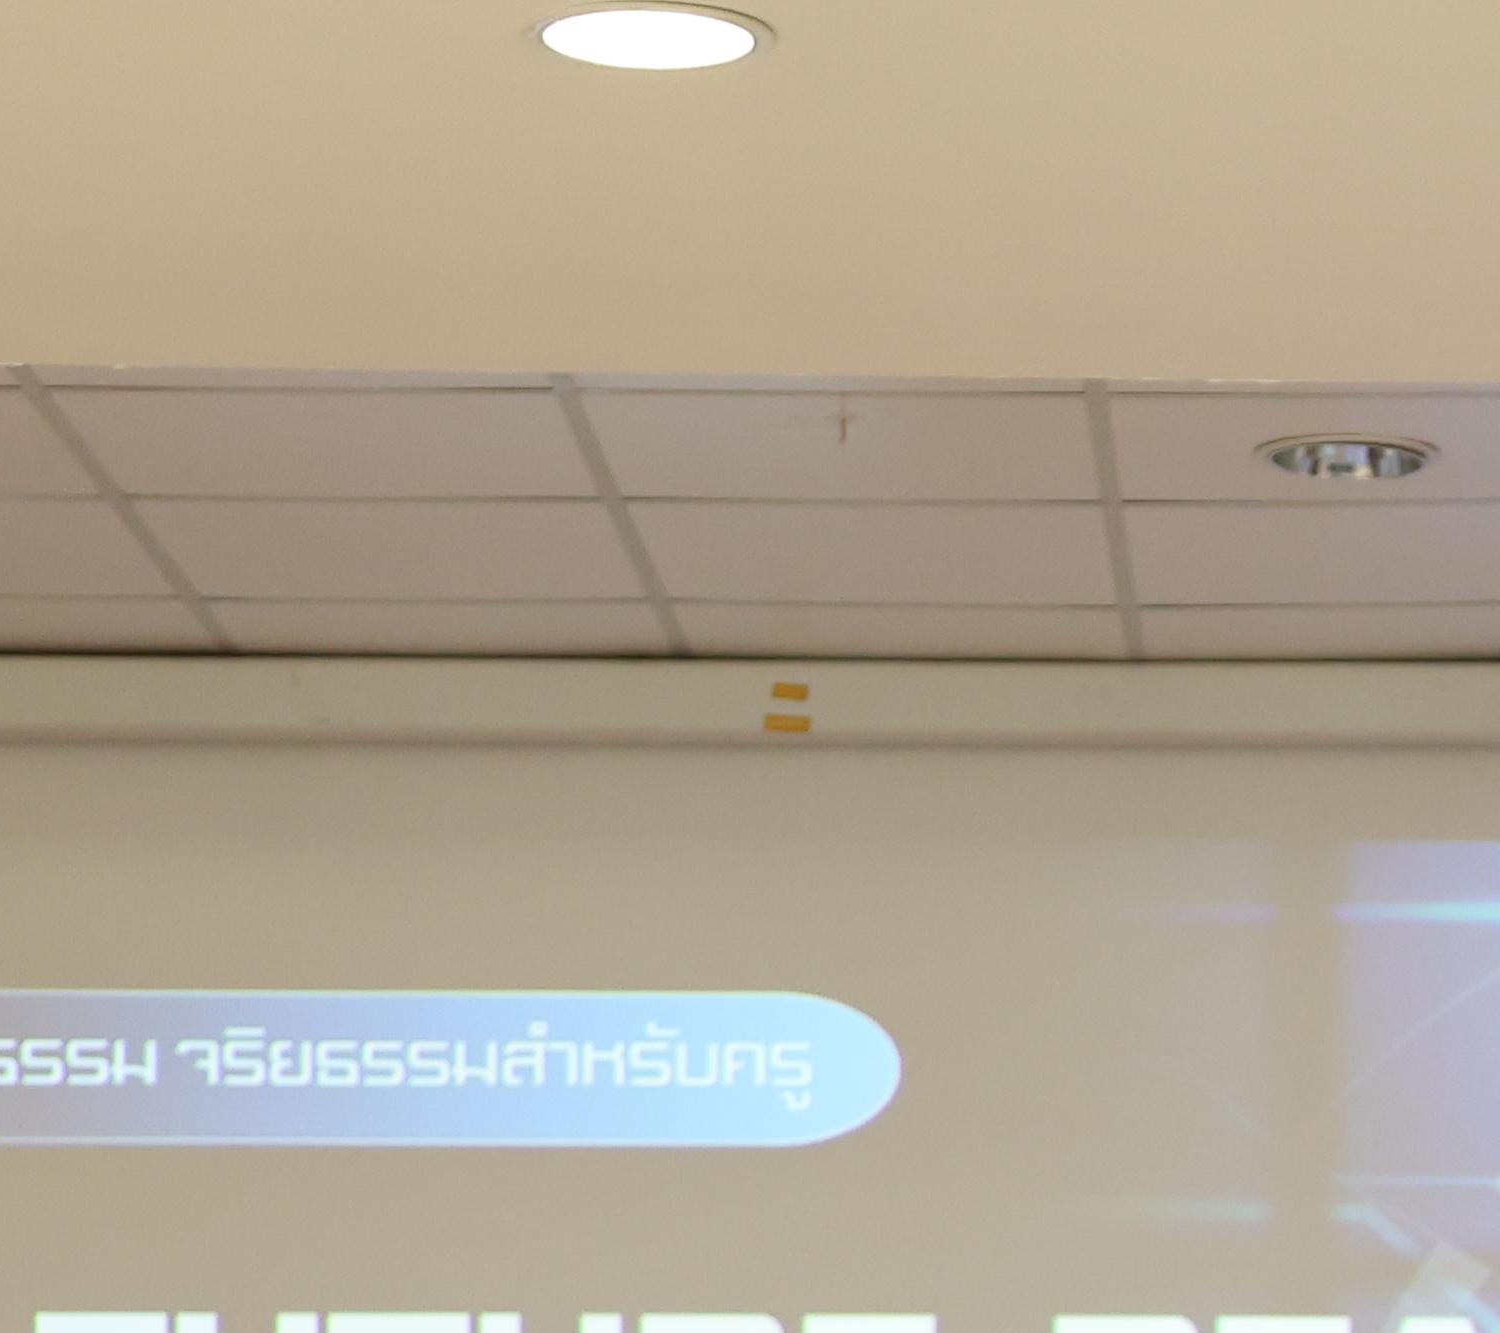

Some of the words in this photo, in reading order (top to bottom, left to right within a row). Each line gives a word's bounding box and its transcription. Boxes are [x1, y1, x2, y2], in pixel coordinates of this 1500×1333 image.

[174, 1019, 814, 1109] จริยธรรมสำหรับครู
